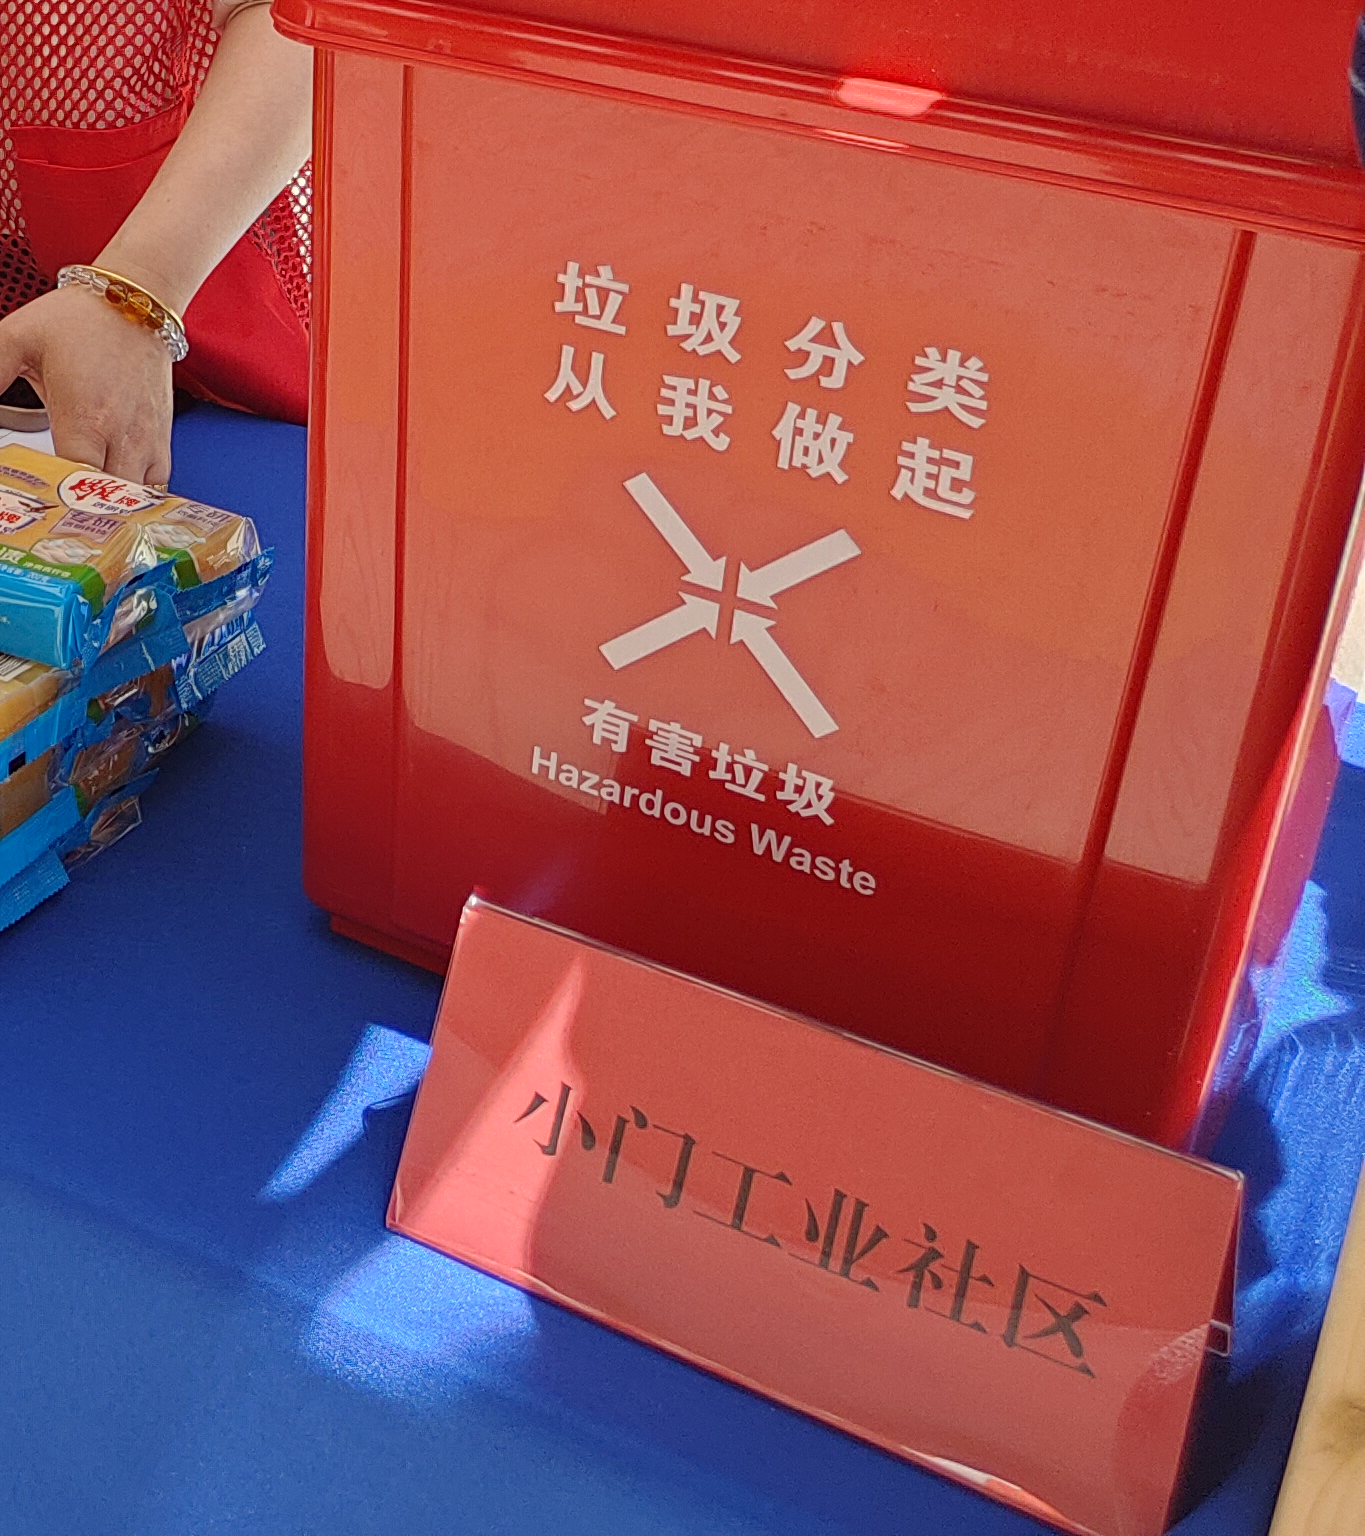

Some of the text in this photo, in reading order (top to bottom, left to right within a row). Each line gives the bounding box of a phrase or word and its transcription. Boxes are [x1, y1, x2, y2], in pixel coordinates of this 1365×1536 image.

[552, 259, 990, 429] 垃圾分类
[544, 343, 977, 521] 从我做起
[68, 509, 124, 531] 专研
[530, 745, 879, 897] Hazardous Waste
[581, 694, 838, 827] 有害垃圾
[513, 1080, 1109, 1381] 小门工业社区
